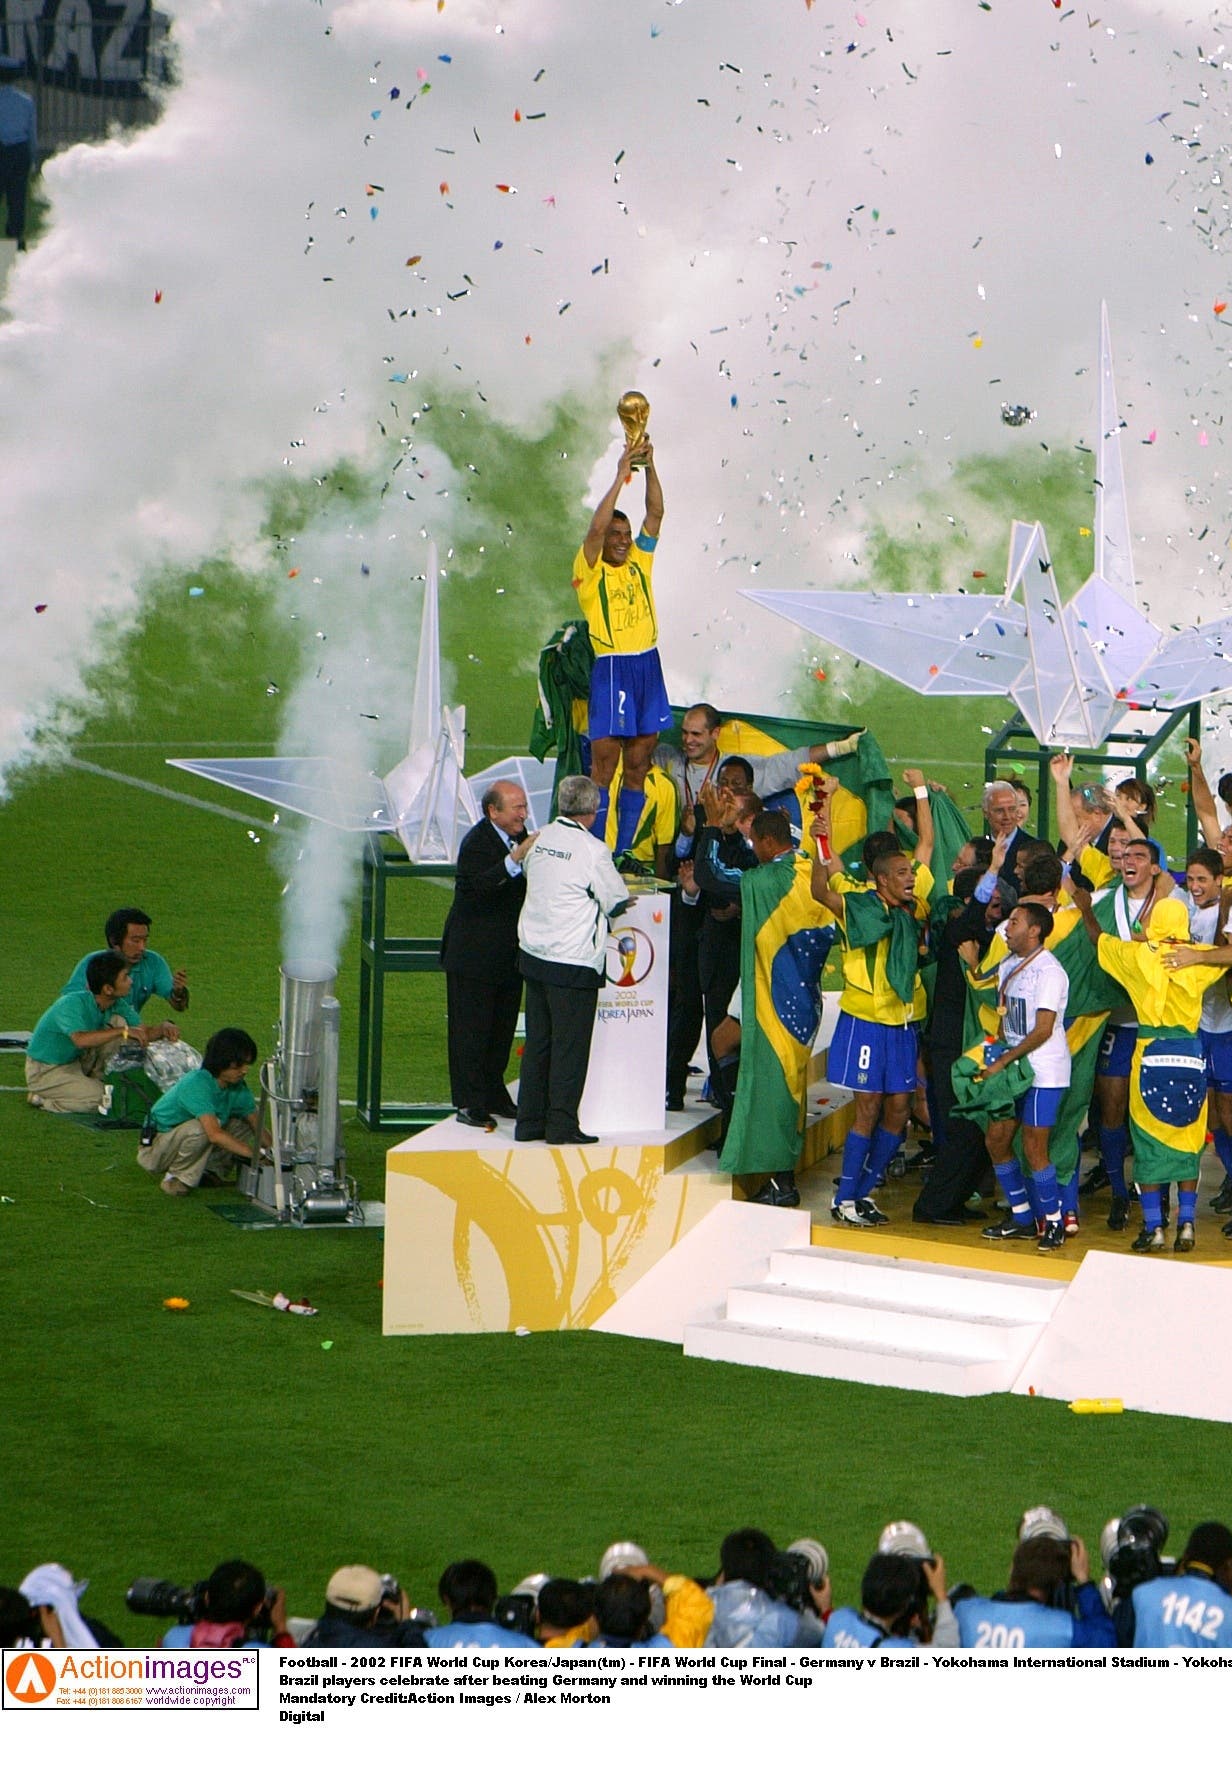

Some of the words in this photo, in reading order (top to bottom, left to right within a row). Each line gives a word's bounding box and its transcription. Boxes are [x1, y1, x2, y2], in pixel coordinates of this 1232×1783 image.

[618, 690, 626, 715] 2
[858, 1045, 871, 1070] 8
[1161, 1591, 1225, 1640] 1142
